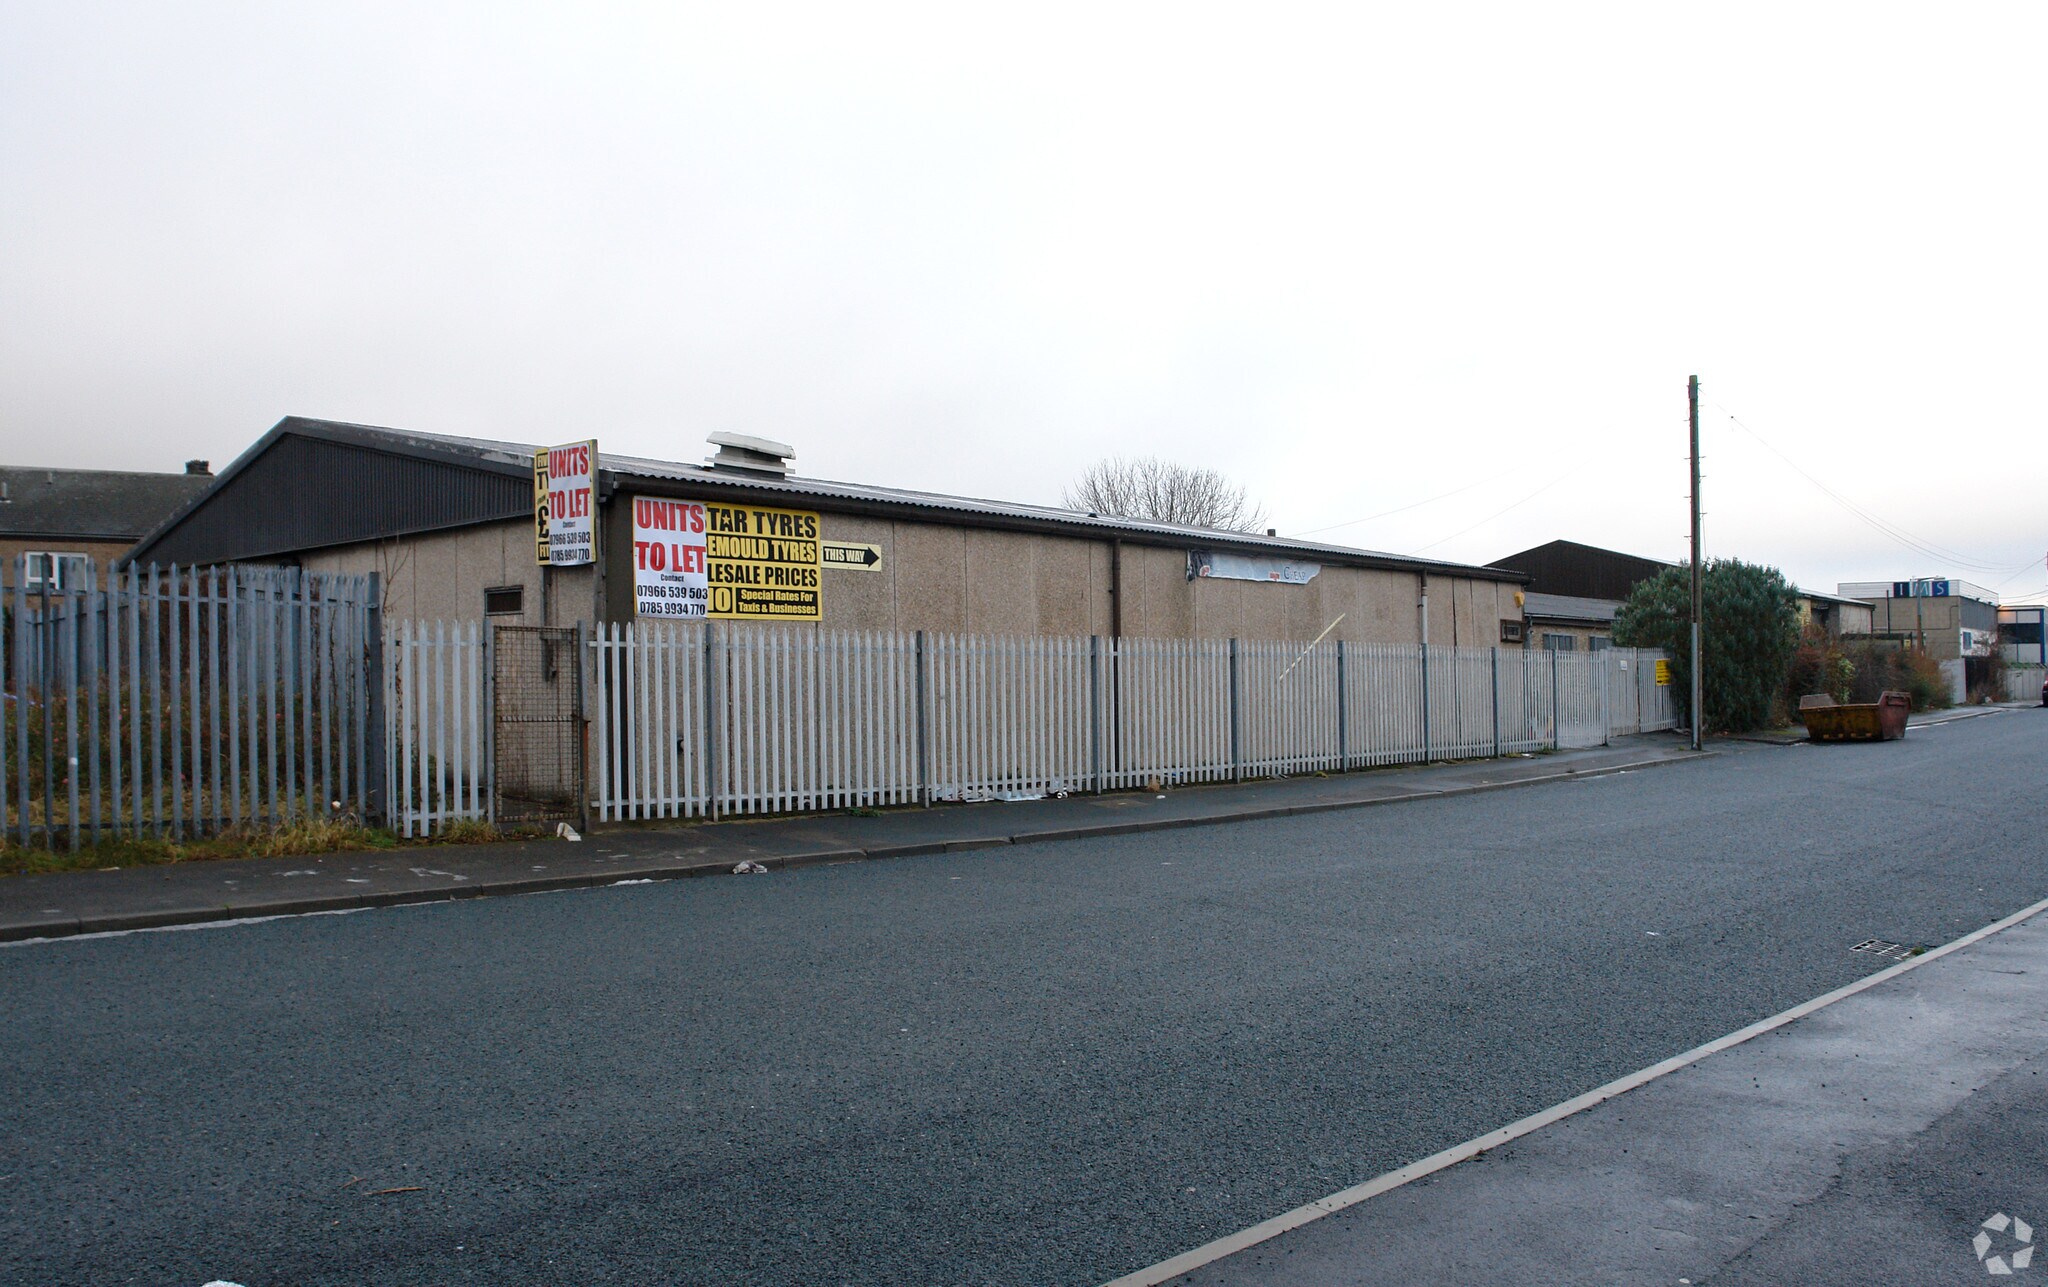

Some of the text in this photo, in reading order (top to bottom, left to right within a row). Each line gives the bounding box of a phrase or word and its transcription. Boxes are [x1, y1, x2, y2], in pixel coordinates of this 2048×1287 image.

[549, 445, 588, 479] UNITS
[549, 488, 590, 519] TO LET
[637, 499, 704, 533] UNITS
[706, 507, 816, 538] TAR TYRES
[578, 531, 591, 543] 503
[578, 548, 590, 560] 770
[635, 541, 706, 573] TO LET
[771, 540, 816, 563] TYRES
[825, 547, 865, 562] THIS WAY
[661, 574, 684, 582] Contact
[765, 566, 817, 587] PRICES
[637, 585, 708, 600] 07966 539 503
[741, 589, 813, 602] Special Rates For
[640, 602, 706, 616] 0785 9934 770
[738, 602, 816, 614] Taxis & Businesses
